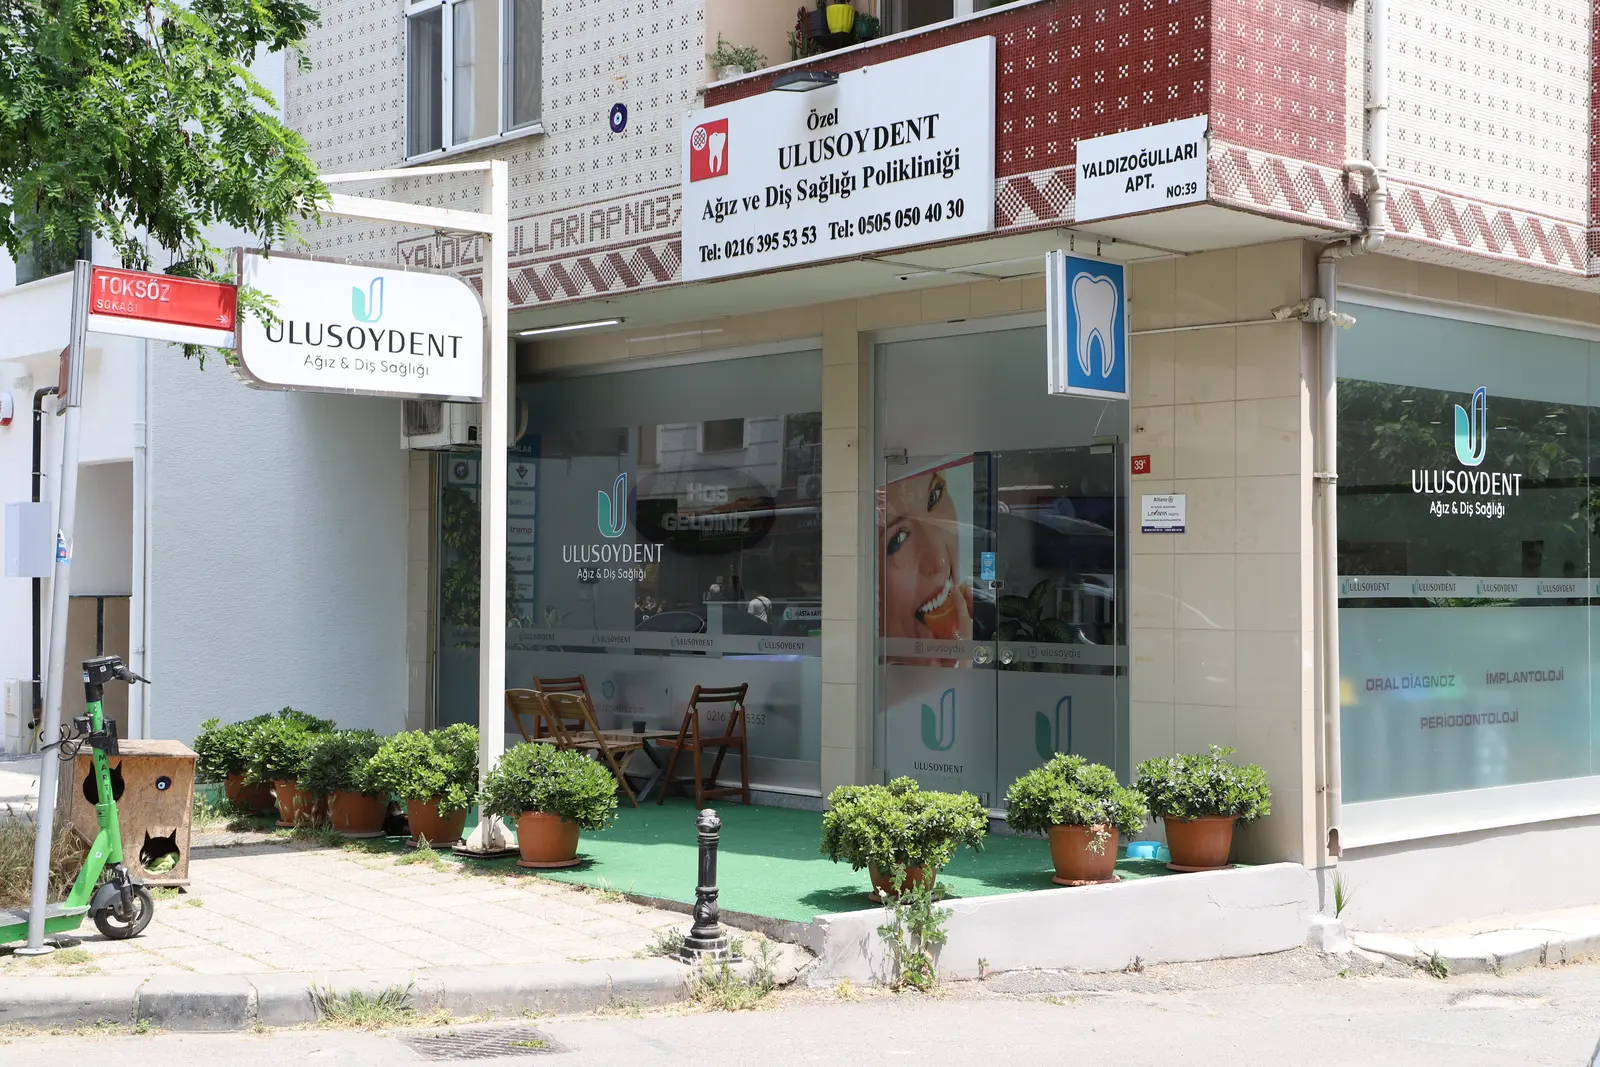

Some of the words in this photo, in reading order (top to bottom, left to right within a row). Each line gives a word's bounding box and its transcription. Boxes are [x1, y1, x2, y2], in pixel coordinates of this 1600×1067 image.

[807, 108, 839, 131] Özel
[778, 114, 940, 170] ULUSOYDENT
[1082, 142, 1198, 179] YALDIZOĞULLARI
[702, 196, 738, 223] Ağız
[742, 194, 760, 212] ve
[765, 184, 792, 209] Diş
[797, 170, 856, 203] Sağlığı
[862, 147, 960, 190] Polikliniği
[1125, 173, 1155, 193] APT.
[1166, 182, 1197, 198] NO:39
[828, 220, 854, 240] Tel:
[858, 212, 891, 235] 0505
[895, 206, 921, 229] 050
[925, 203, 942, 223] 40
[946, 198, 965, 220] 30
[699, 244, 721, 263] Tel:
[724, 237, 754, 259] 0216
[757, 232, 779, 252] 395
[783, 230, 798, 249] 53
[801, 226, 817, 245] 53
[98, 275, 171, 302] TOKSÖZ
[96, 299, 138, 313] SOKAĞI
[266, 318, 463, 358] ULUSOYDENT
[304, 354, 336, 370] Ağız
[341, 357, 350, 369] &
[355, 358, 376, 373] Diş
[380, 361, 429, 378] Sağlığı
[1411, 469, 1522, 496] ULUSOYDENT
[1429, 501, 1450, 518] Ağız
[1452, 504, 1458, 514] &
[1460, 502, 1473, 517] Diş
[1475, 502, 1505, 518] Sağlığı
[562, 543, 664, 563] ULUSOYDENT
[577, 568, 596, 581] Ağız
[596, 569, 602, 579] &
[603, 568, 616, 581] Diş
[618, 567, 647, 582] Sağlığı
[1349, 582, 1390, 592] ULUSOYDENT
[1419, 583, 1456, 592] ULUSOYDENT
[1483, 583, 1518, 593] ULUSOYDENT
[1542, 584, 1576, 593] ULUSOYDENT
[677, 638, 714, 647] ULUSOYDENT
[764, 640, 805, 650] ULUSOYDENT
[1366, 678, 1400, 692] ORAL
[1401, 673, 1456, 690] DİAGNOZ
[1486, 666, 1564, 685] İMPLANTOLOJİ
[706, 710, 726, 722] 0216
[1420, 708, 1519, 730] PERİODONTOLOJİ
[913, 761, 964, 774] ULUSOYDENT
